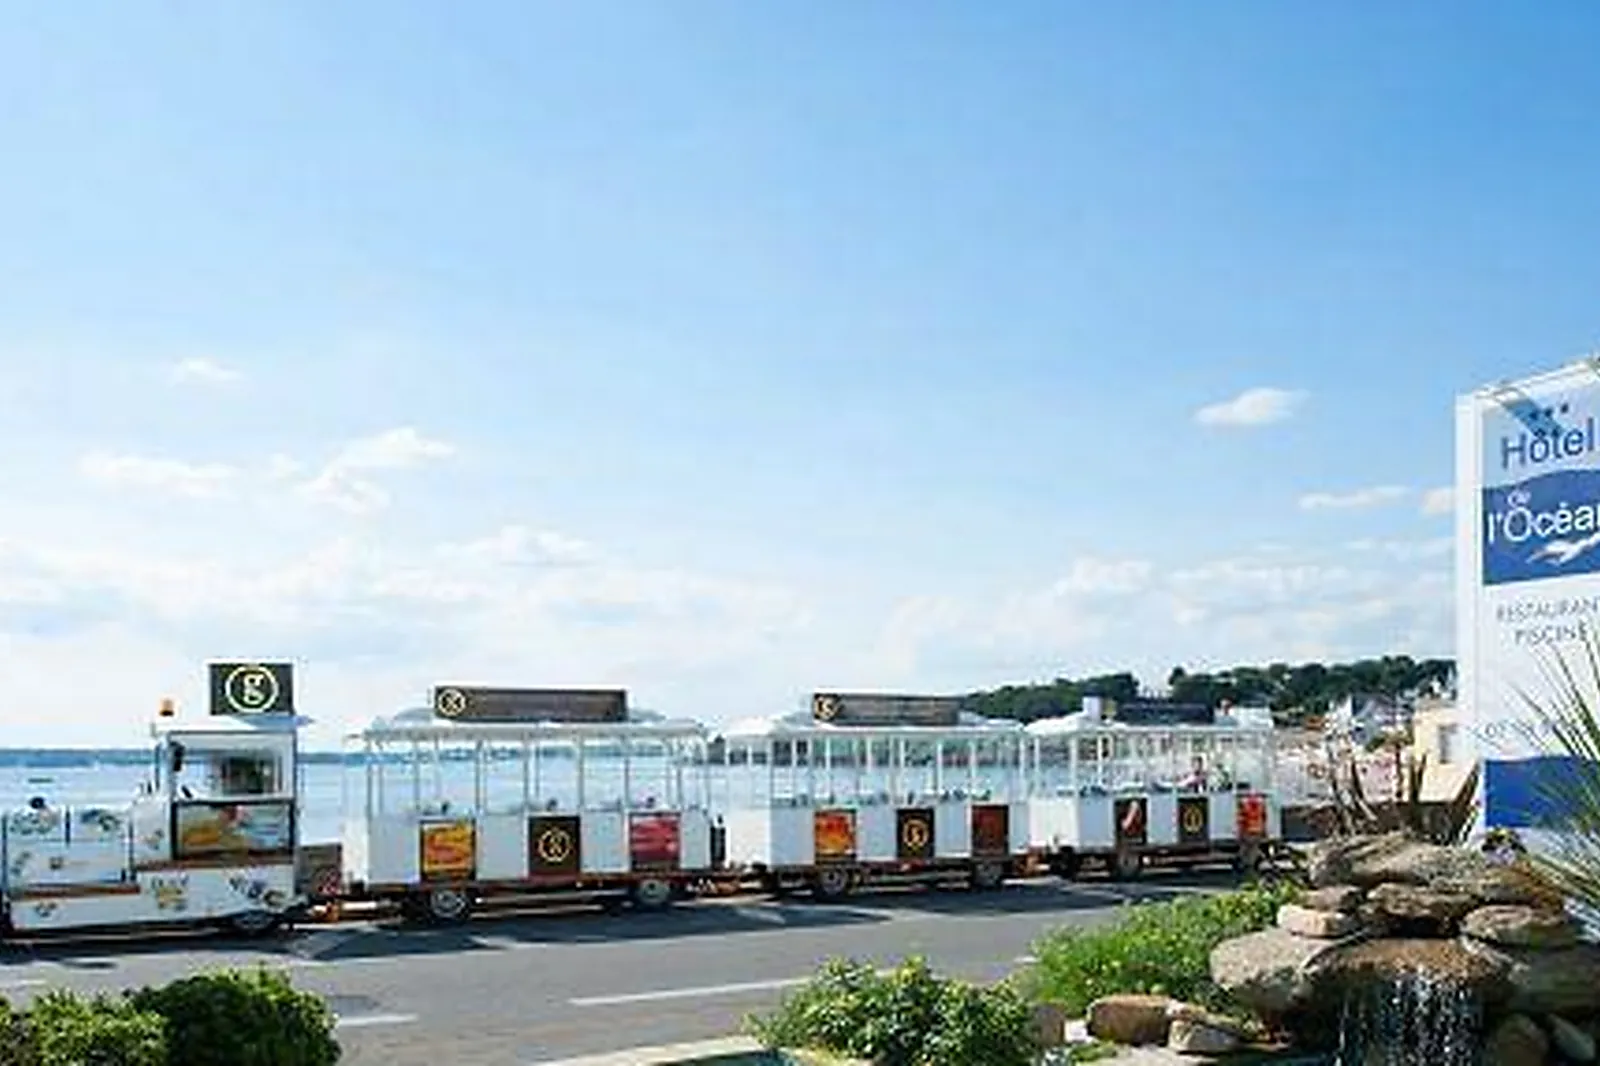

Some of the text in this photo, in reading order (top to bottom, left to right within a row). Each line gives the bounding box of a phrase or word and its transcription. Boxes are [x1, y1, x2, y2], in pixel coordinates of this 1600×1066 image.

[1502, 417, 1594, 470] Hôtel
[1488, 501, 1600, 544] l'Océa
[1497, 597, 1600, 622] RESTAURAN
